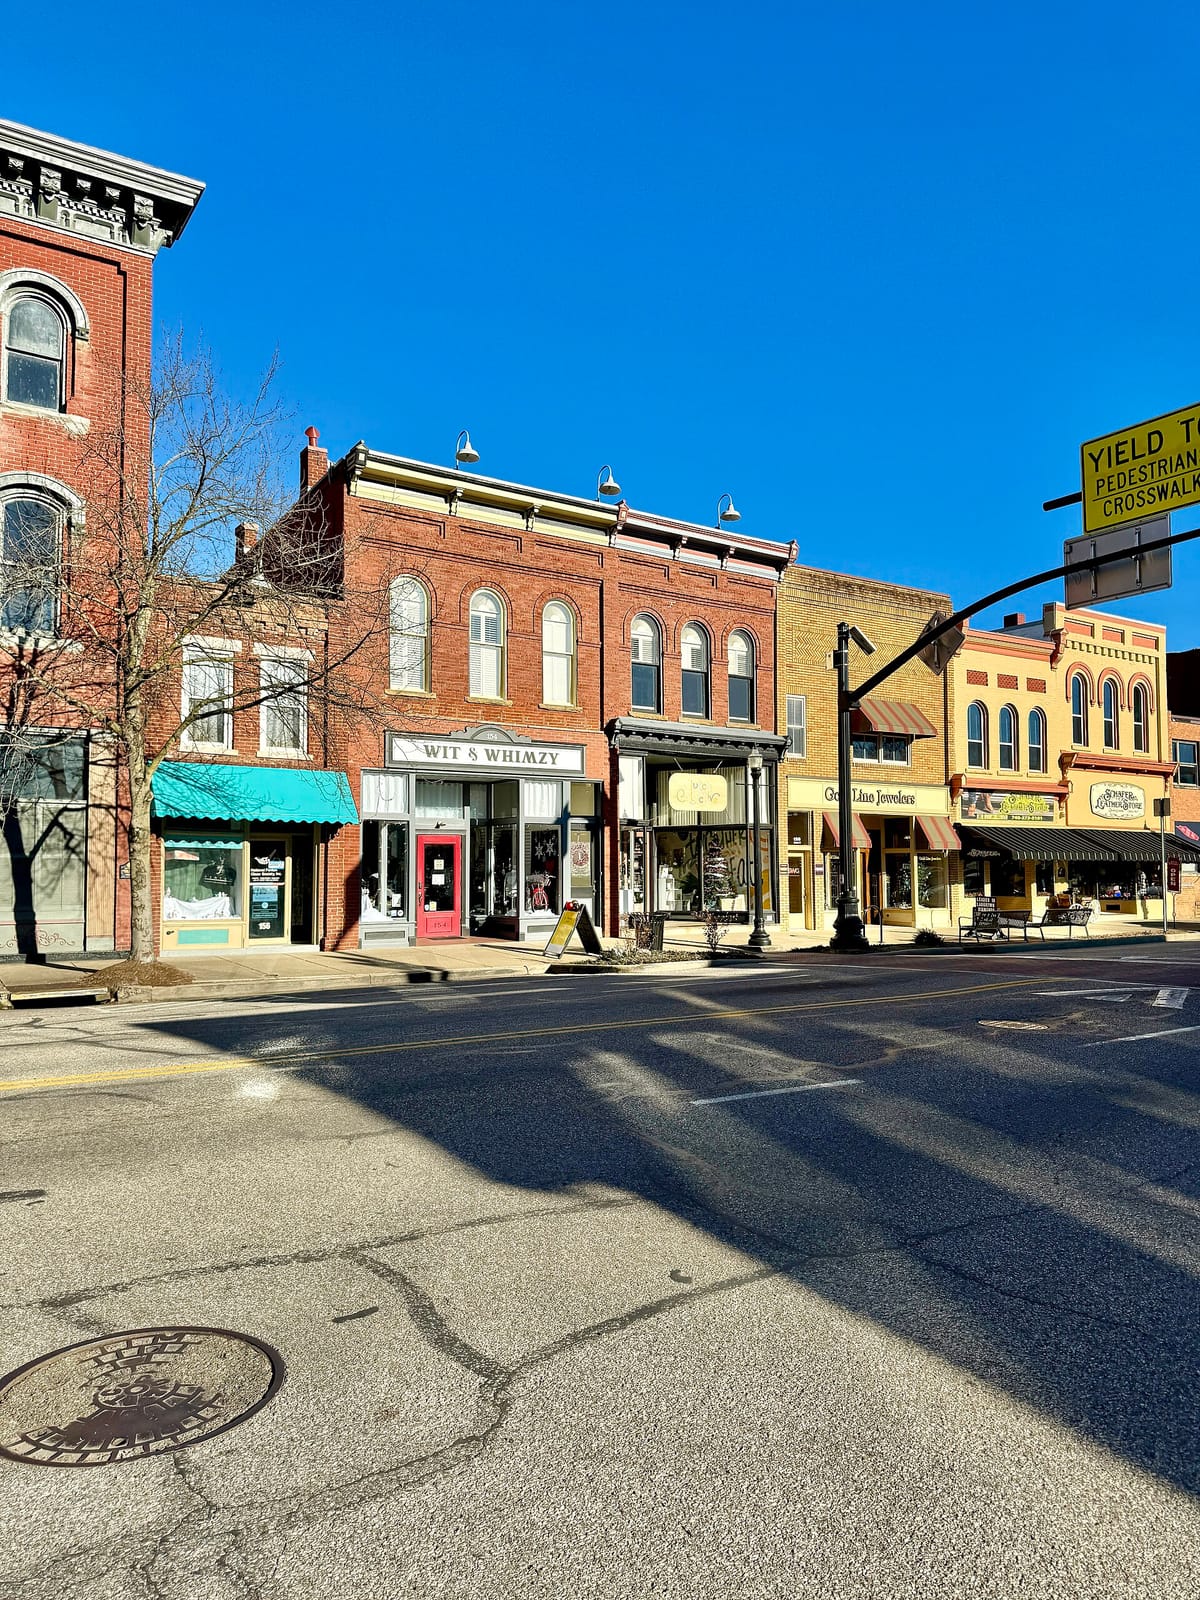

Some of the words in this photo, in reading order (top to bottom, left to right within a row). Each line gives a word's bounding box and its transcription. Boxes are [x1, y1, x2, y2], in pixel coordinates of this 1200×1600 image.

[1088, 429, 1164, 473] YIELD
[1180, 417, 1200, 444] T
[1096, 448, 1200, 497] PEDESTRIAN
[1103, 473, 1200, 517] CROSSWALK
[423, 744, 461, 760] WIT
[484, 748, 559, 766] WHIMZY
[851, 788, 875, 804] Line
[876, 789, 916, 806] Jewelers
